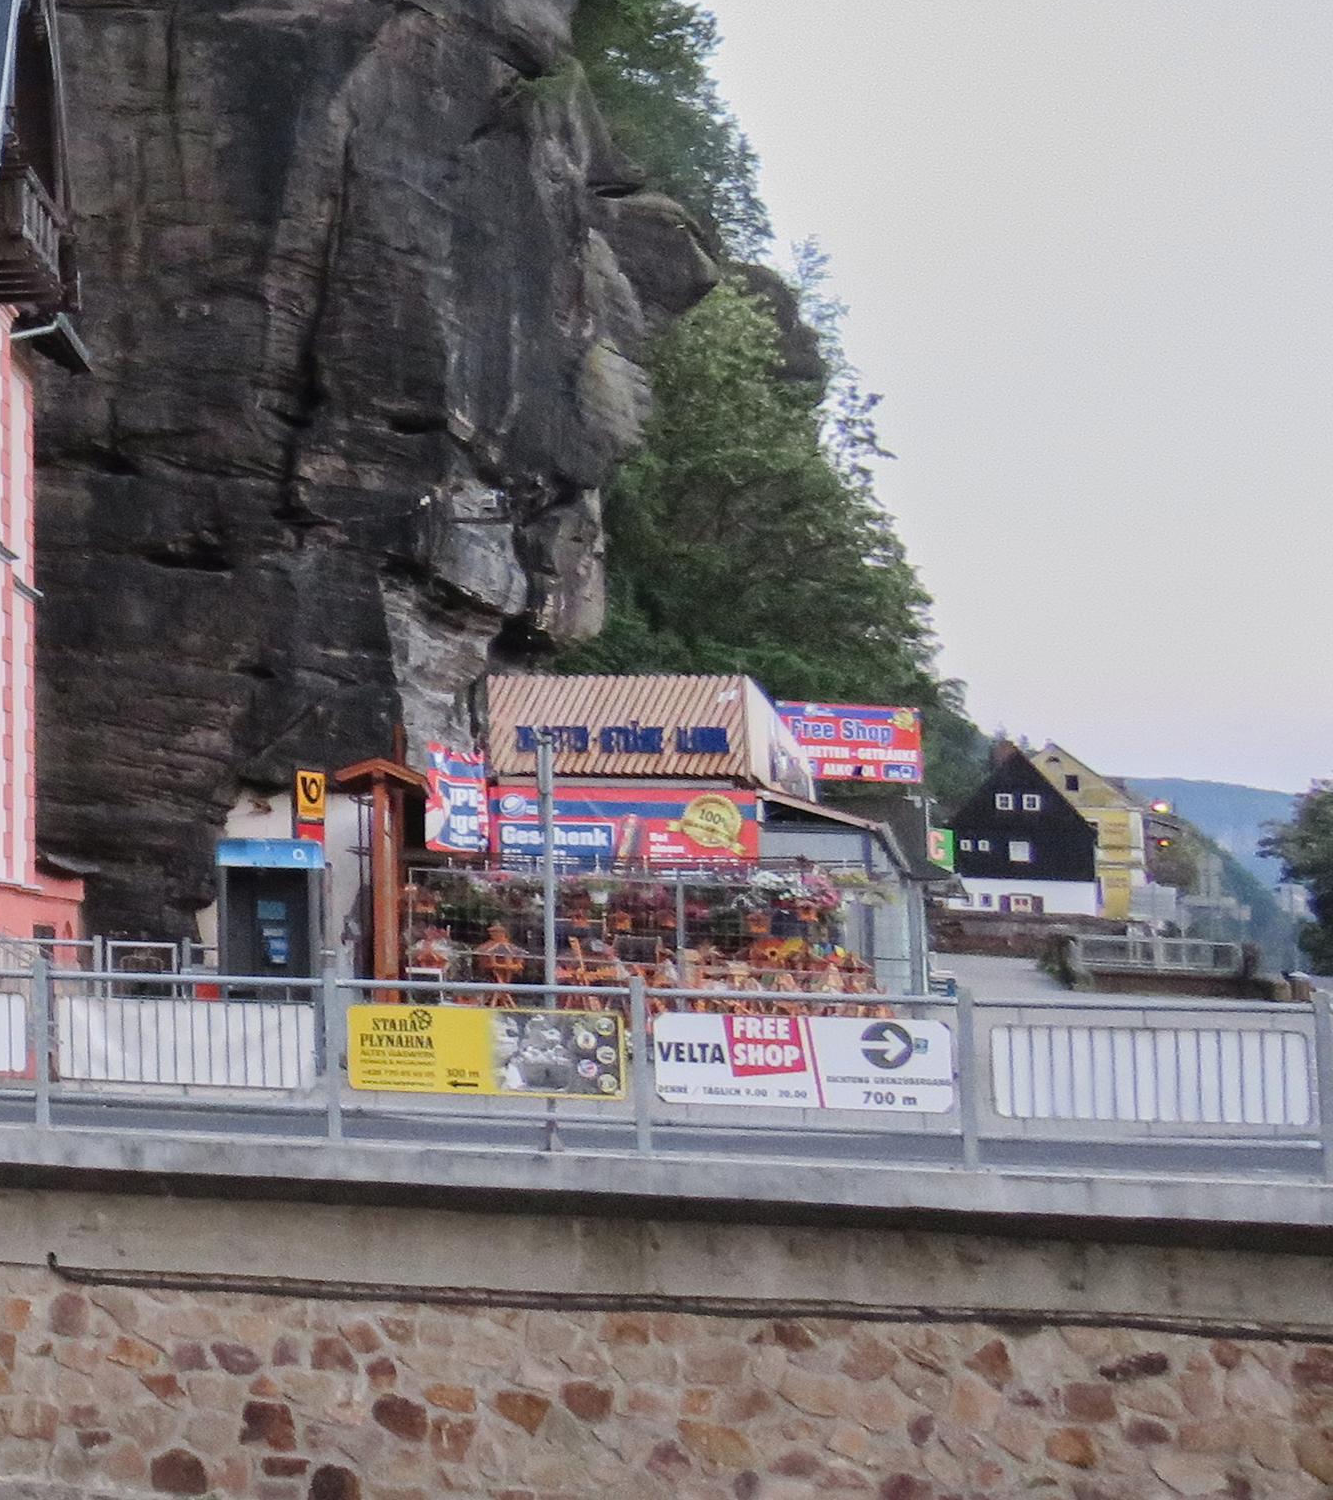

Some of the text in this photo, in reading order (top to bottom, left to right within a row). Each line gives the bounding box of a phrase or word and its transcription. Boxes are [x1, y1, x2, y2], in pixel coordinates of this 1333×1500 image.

[790, 716, 893, 747] Free Shop
[823, 762, 876, 777] ALKOOL
[734, 1016, 790, 1039] FREE
[657, 1041, 726, 1064] VELTA
[734, 1042, 800, 1067] SHOP
[863, 1091, 917, 1106] 700 m
